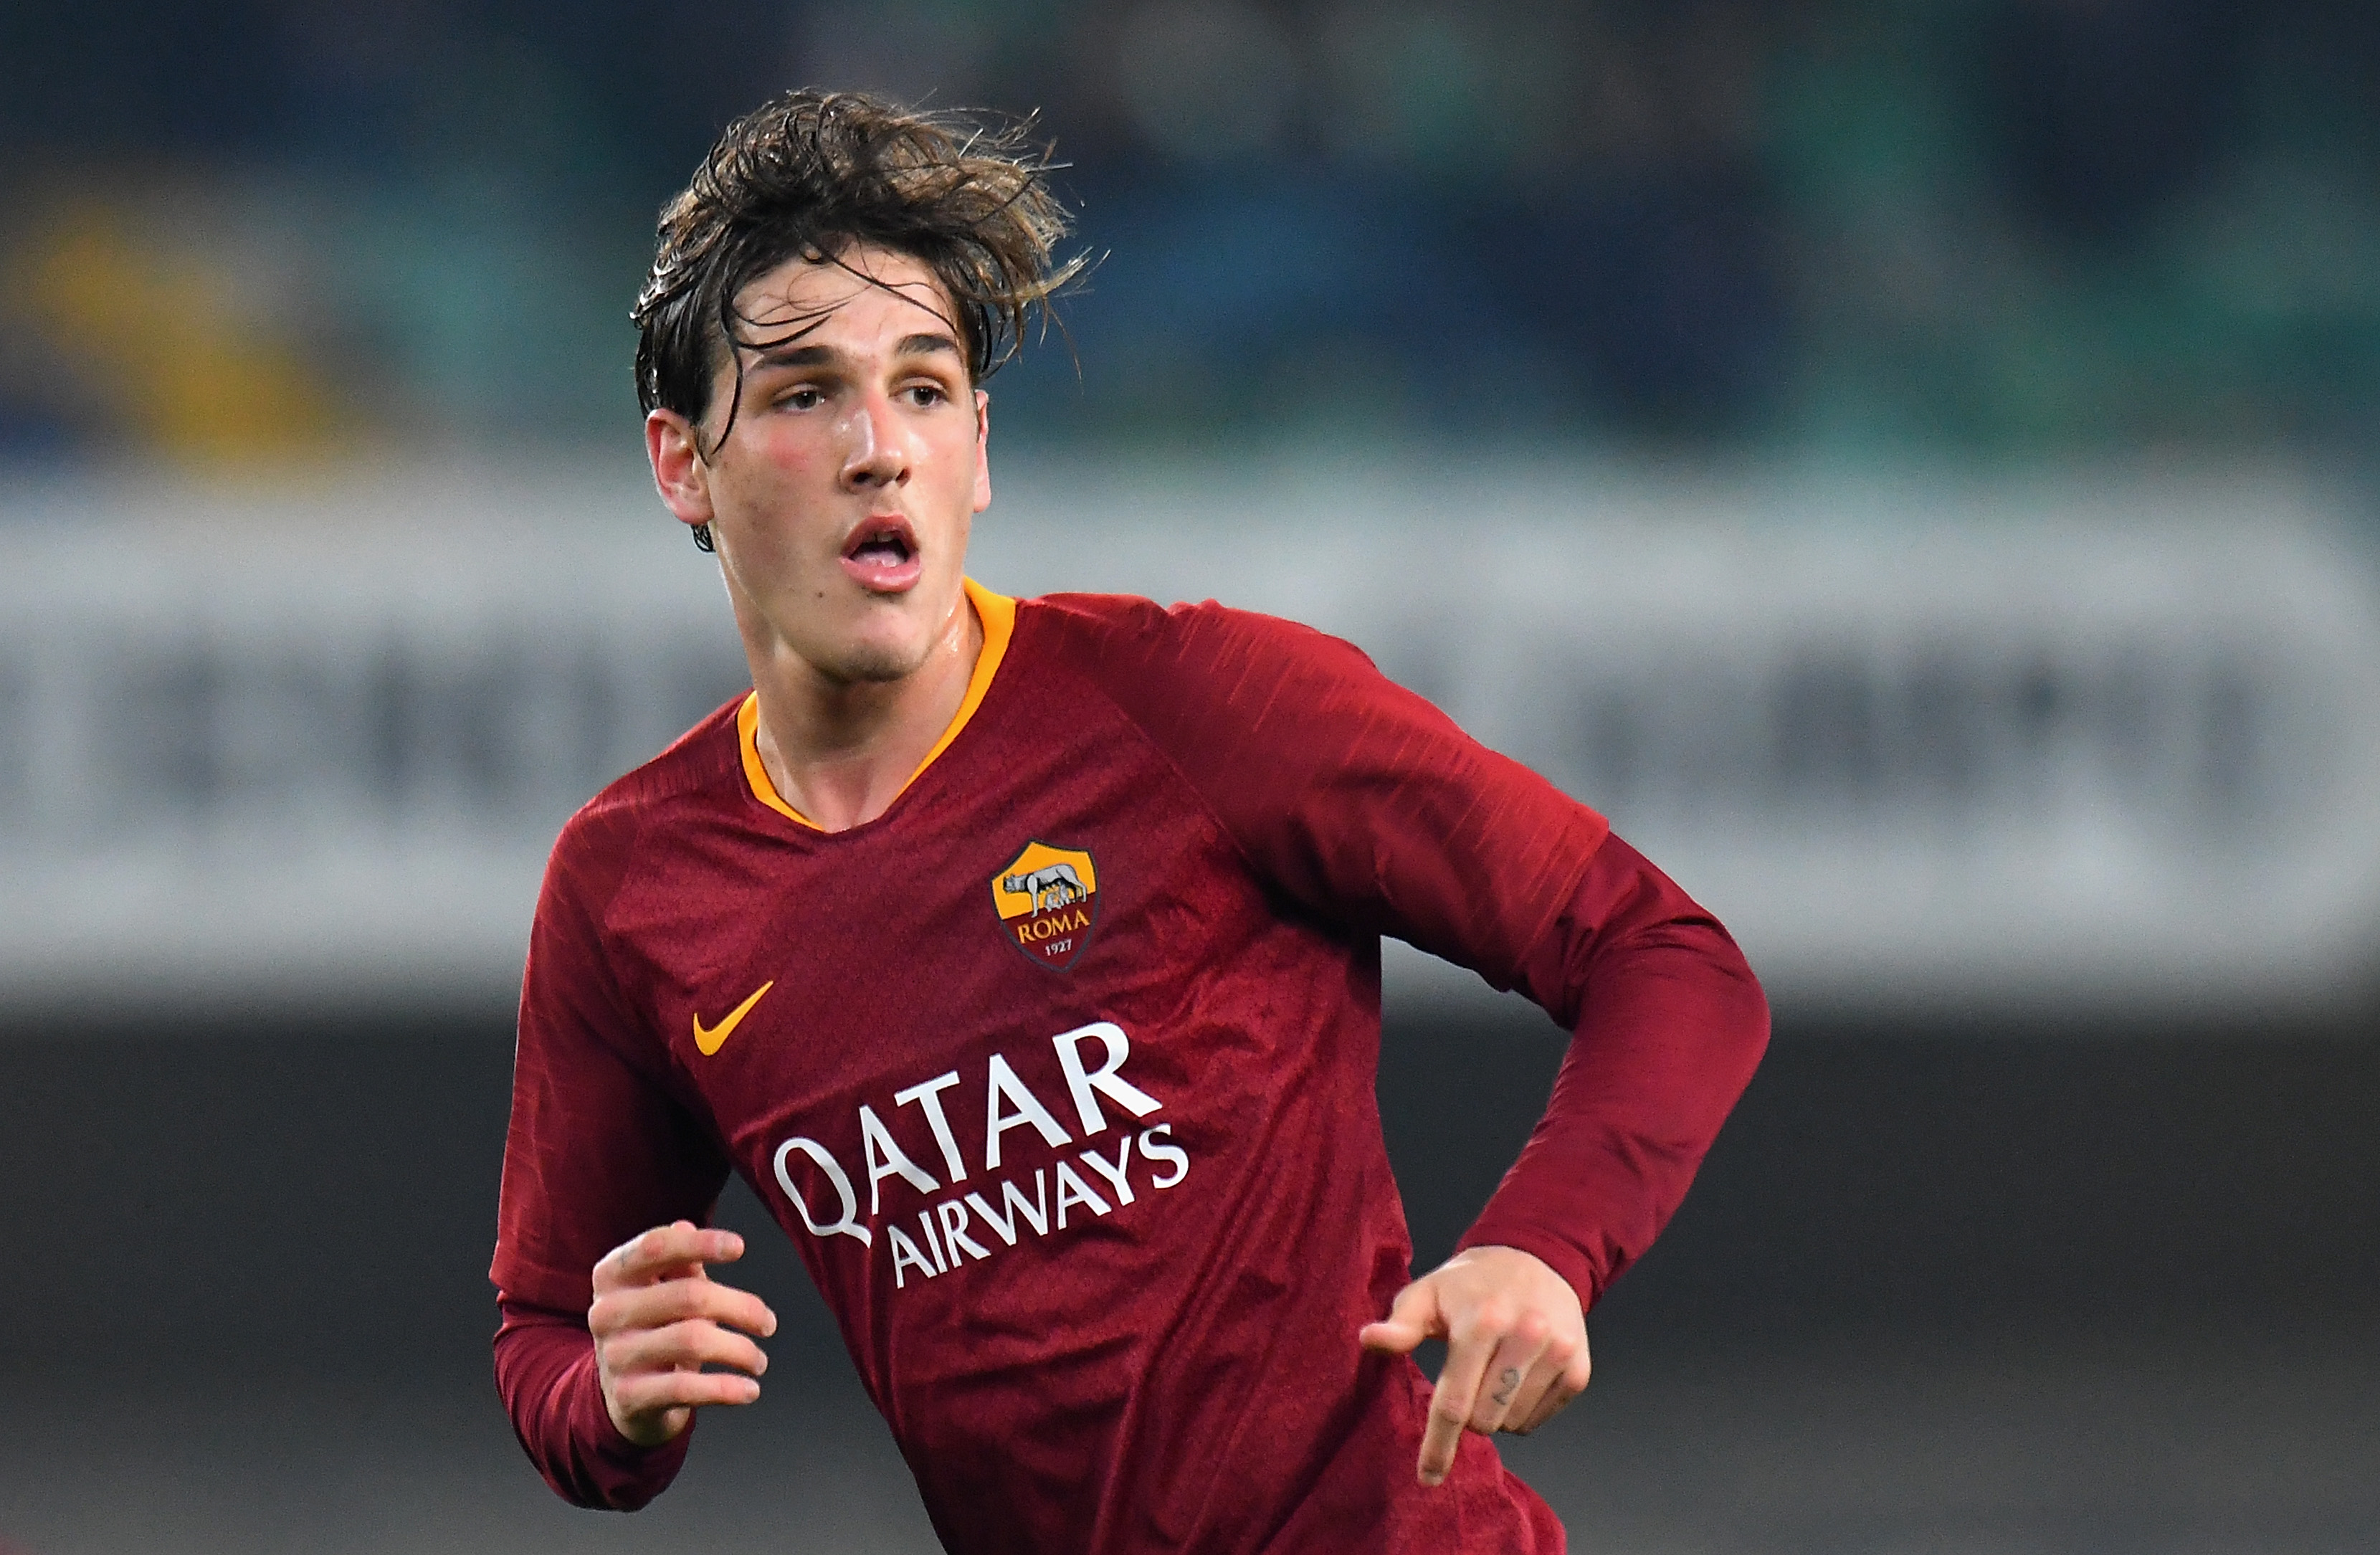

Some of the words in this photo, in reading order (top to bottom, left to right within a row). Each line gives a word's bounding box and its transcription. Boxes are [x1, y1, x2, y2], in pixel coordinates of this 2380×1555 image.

[1017, 909, 1090, 944] ROMA
[1045, 938, 1072, 956] 1927
[774, 1021, 1163, 1249] QATAR
[887, 1123, 1189, 1289] AIRWAYS
